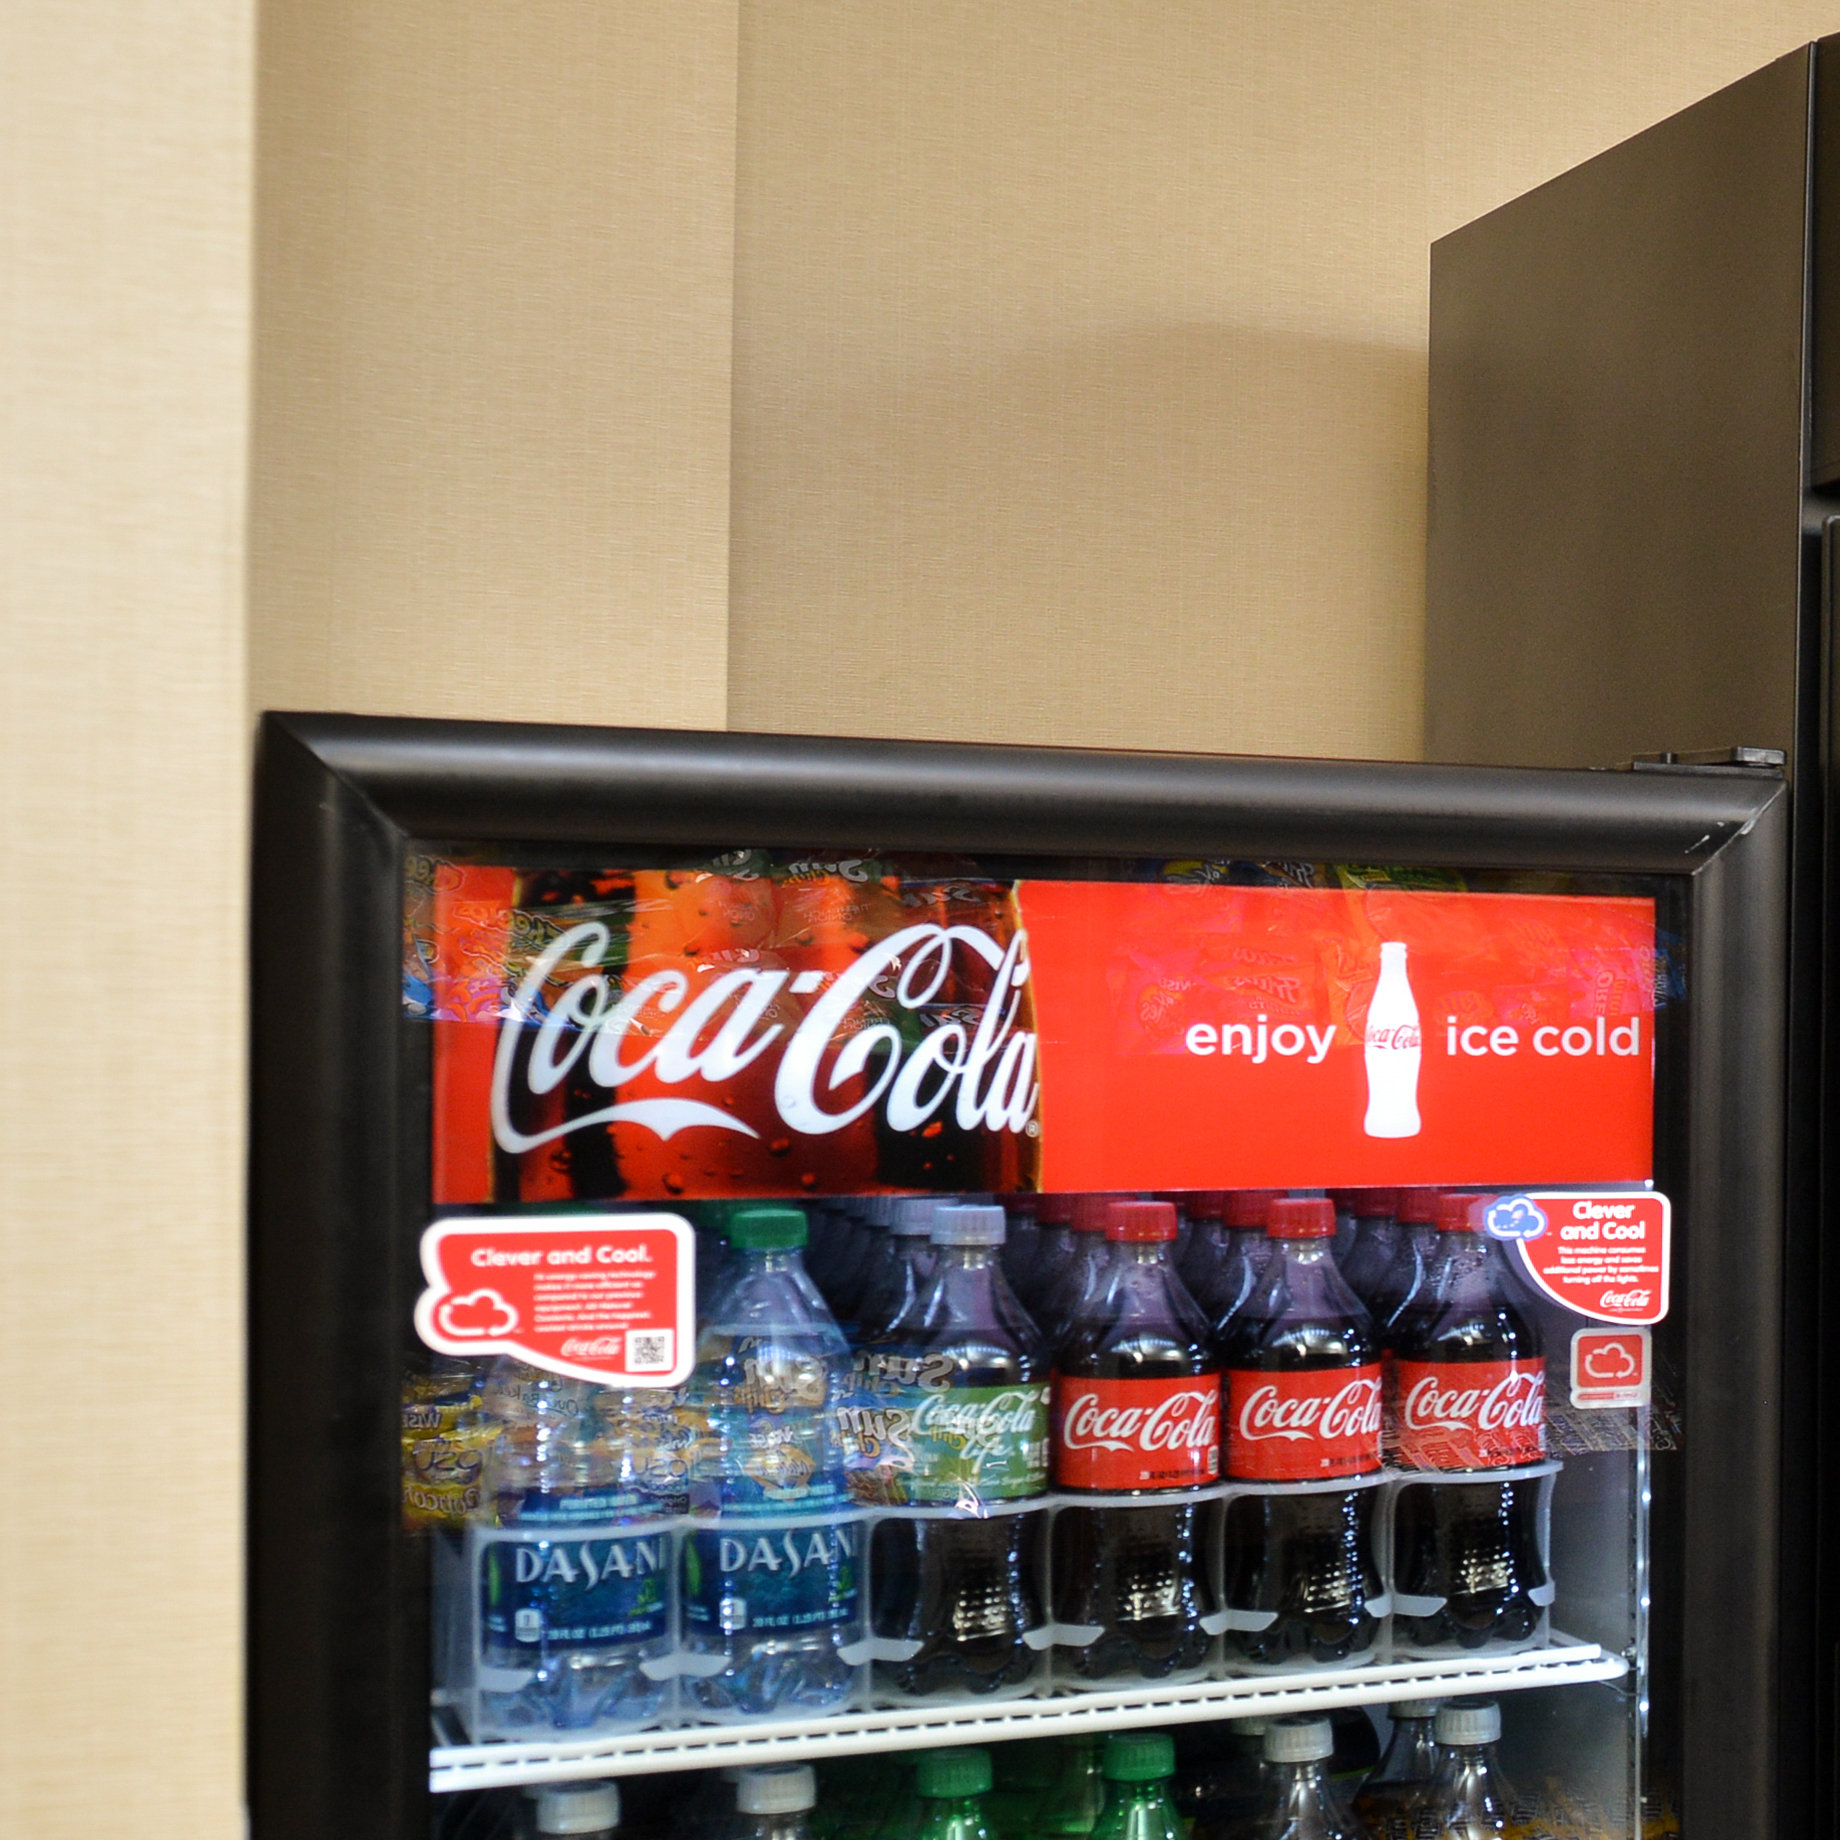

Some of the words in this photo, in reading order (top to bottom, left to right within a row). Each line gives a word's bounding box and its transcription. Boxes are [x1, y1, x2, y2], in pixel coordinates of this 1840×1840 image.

[490, 921, 1038, 1154] Coca-Cola
[1185, 1014, 1337, 1065] enjoy
[1447, 1015, 1519, 1057] ice
[1532, 1016, 1640, 1057] cold
[1572, 1200, 1636, 1221] Clever
[1560, 1222, 1600, 1241] and
[1600, 1221, 1646, 1241] Cool
[470, 1246, 542, 1268] Clever
[546, 1244, 592, 1266] and
[595, 1243, 653, 1265] Cool.
[1599, 1289, 1651, 1308] Coca-Cola
[1404, 1372, 1546, 1431] Coca-Cola
[1062, 1391, 1217, 1452] Coca-Cola
